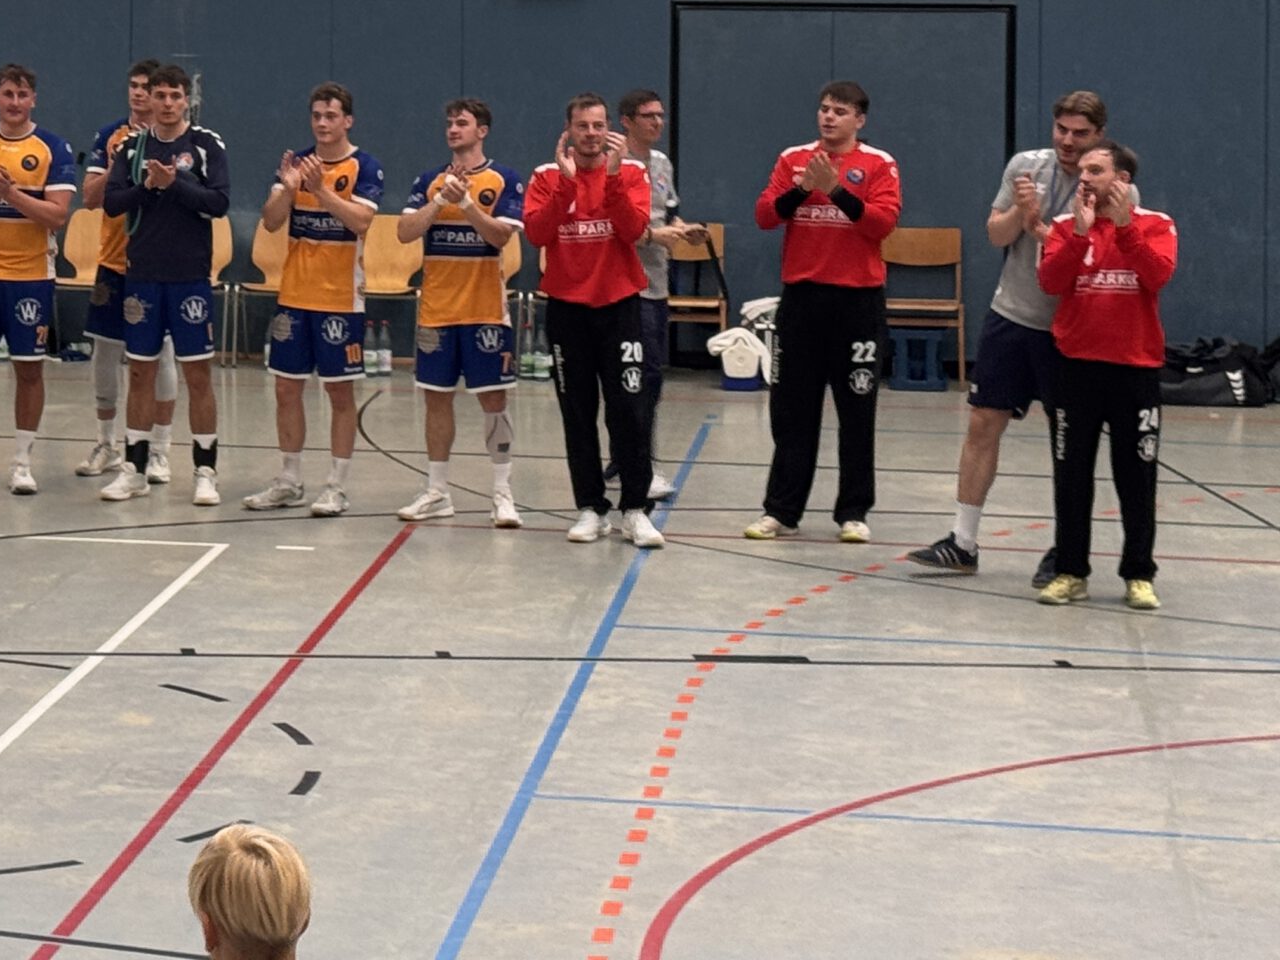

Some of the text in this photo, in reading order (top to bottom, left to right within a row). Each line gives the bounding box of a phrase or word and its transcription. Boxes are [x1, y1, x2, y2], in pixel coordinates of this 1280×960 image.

[620, 341, 643, 363] 20
[851, 341, 877, 363] 22
[1138, 406, 1159, 432] 24
